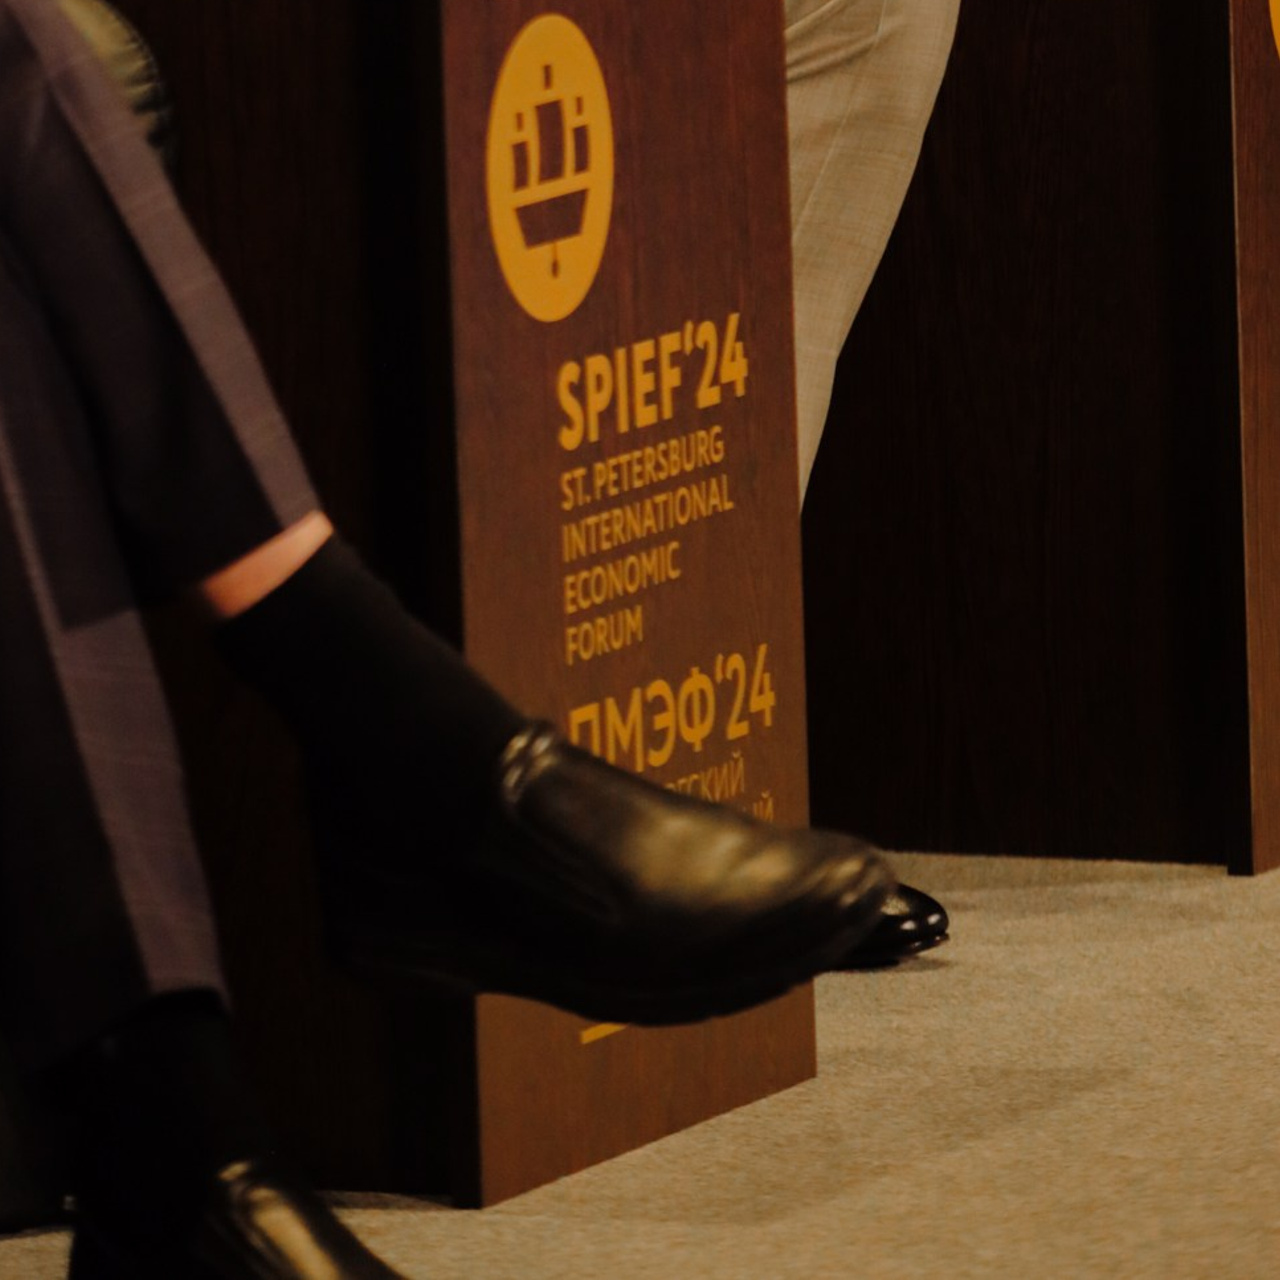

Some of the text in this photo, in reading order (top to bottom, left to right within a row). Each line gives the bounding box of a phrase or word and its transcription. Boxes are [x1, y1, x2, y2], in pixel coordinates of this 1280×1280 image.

[557, 313, 748, 450] SPIEF'24
[561, 425, 724, 511] ST. PETERSBURG
[562, 474, 734, 563] INTERNATIONAL
[563, 541, 680, 615] ECONOMIC
[565, 605, 643, 666] FORUM
